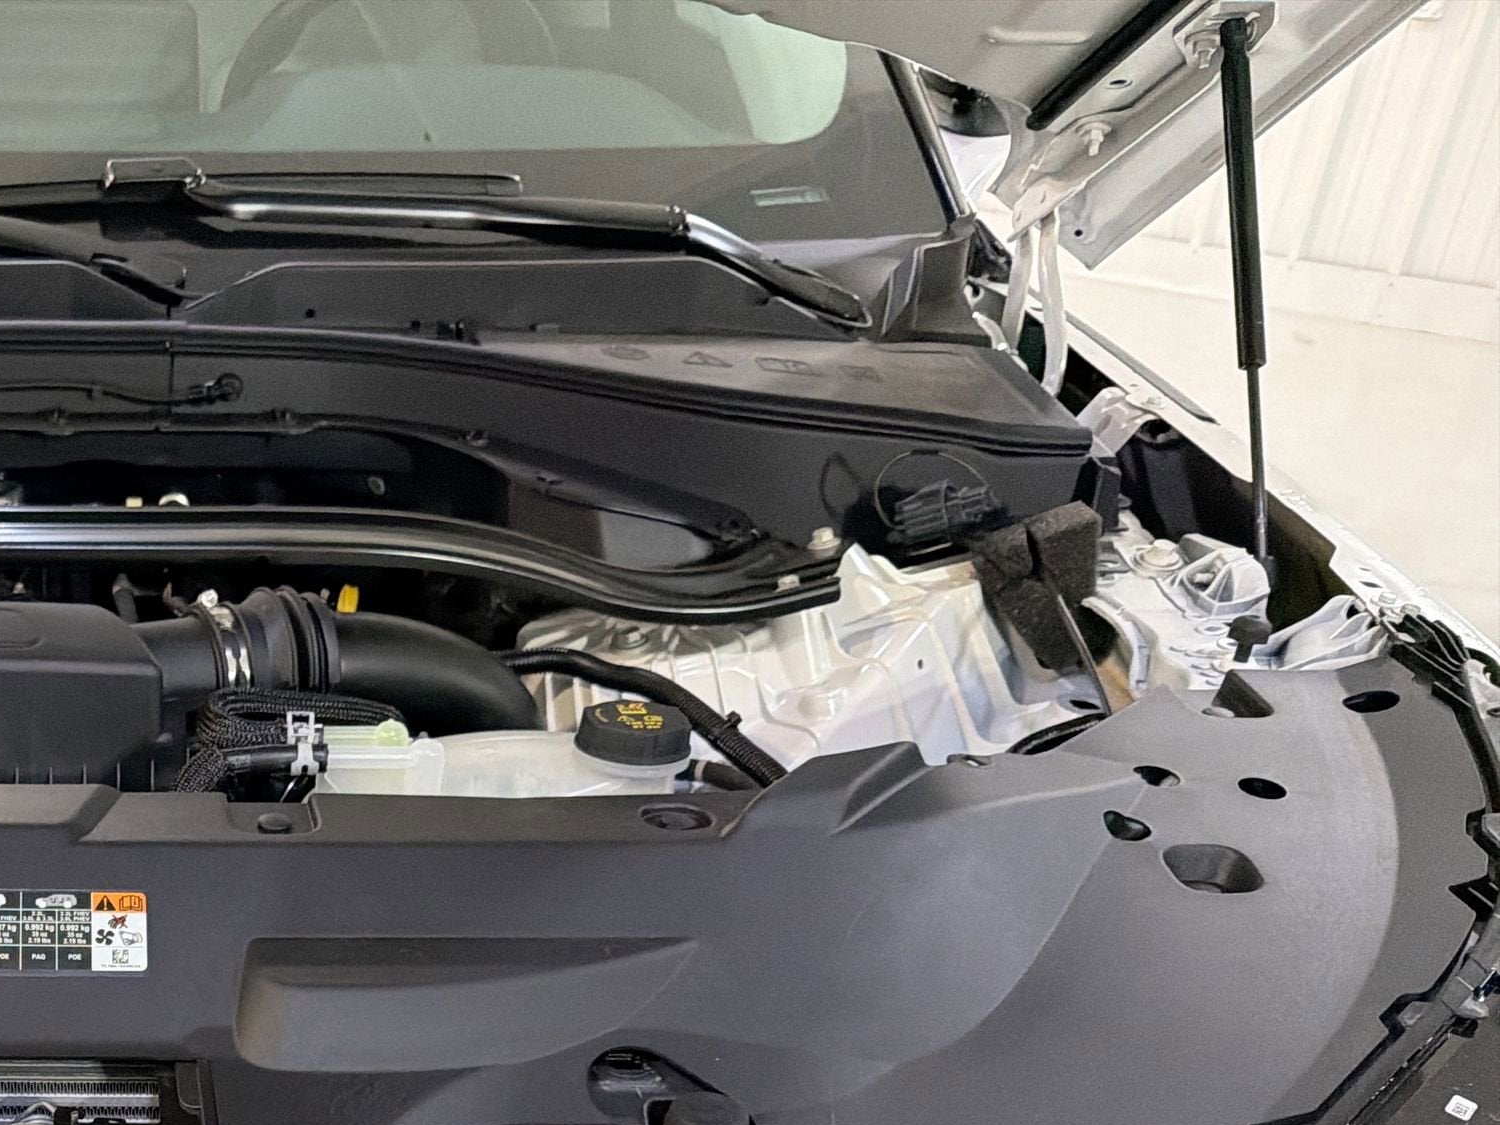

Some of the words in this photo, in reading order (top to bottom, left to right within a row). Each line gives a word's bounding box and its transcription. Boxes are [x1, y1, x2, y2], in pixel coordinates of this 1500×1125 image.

[7, 924, 17, 932] kg
[45, 924, 55, 932] kg
[80, 925, 90, 933] kg
